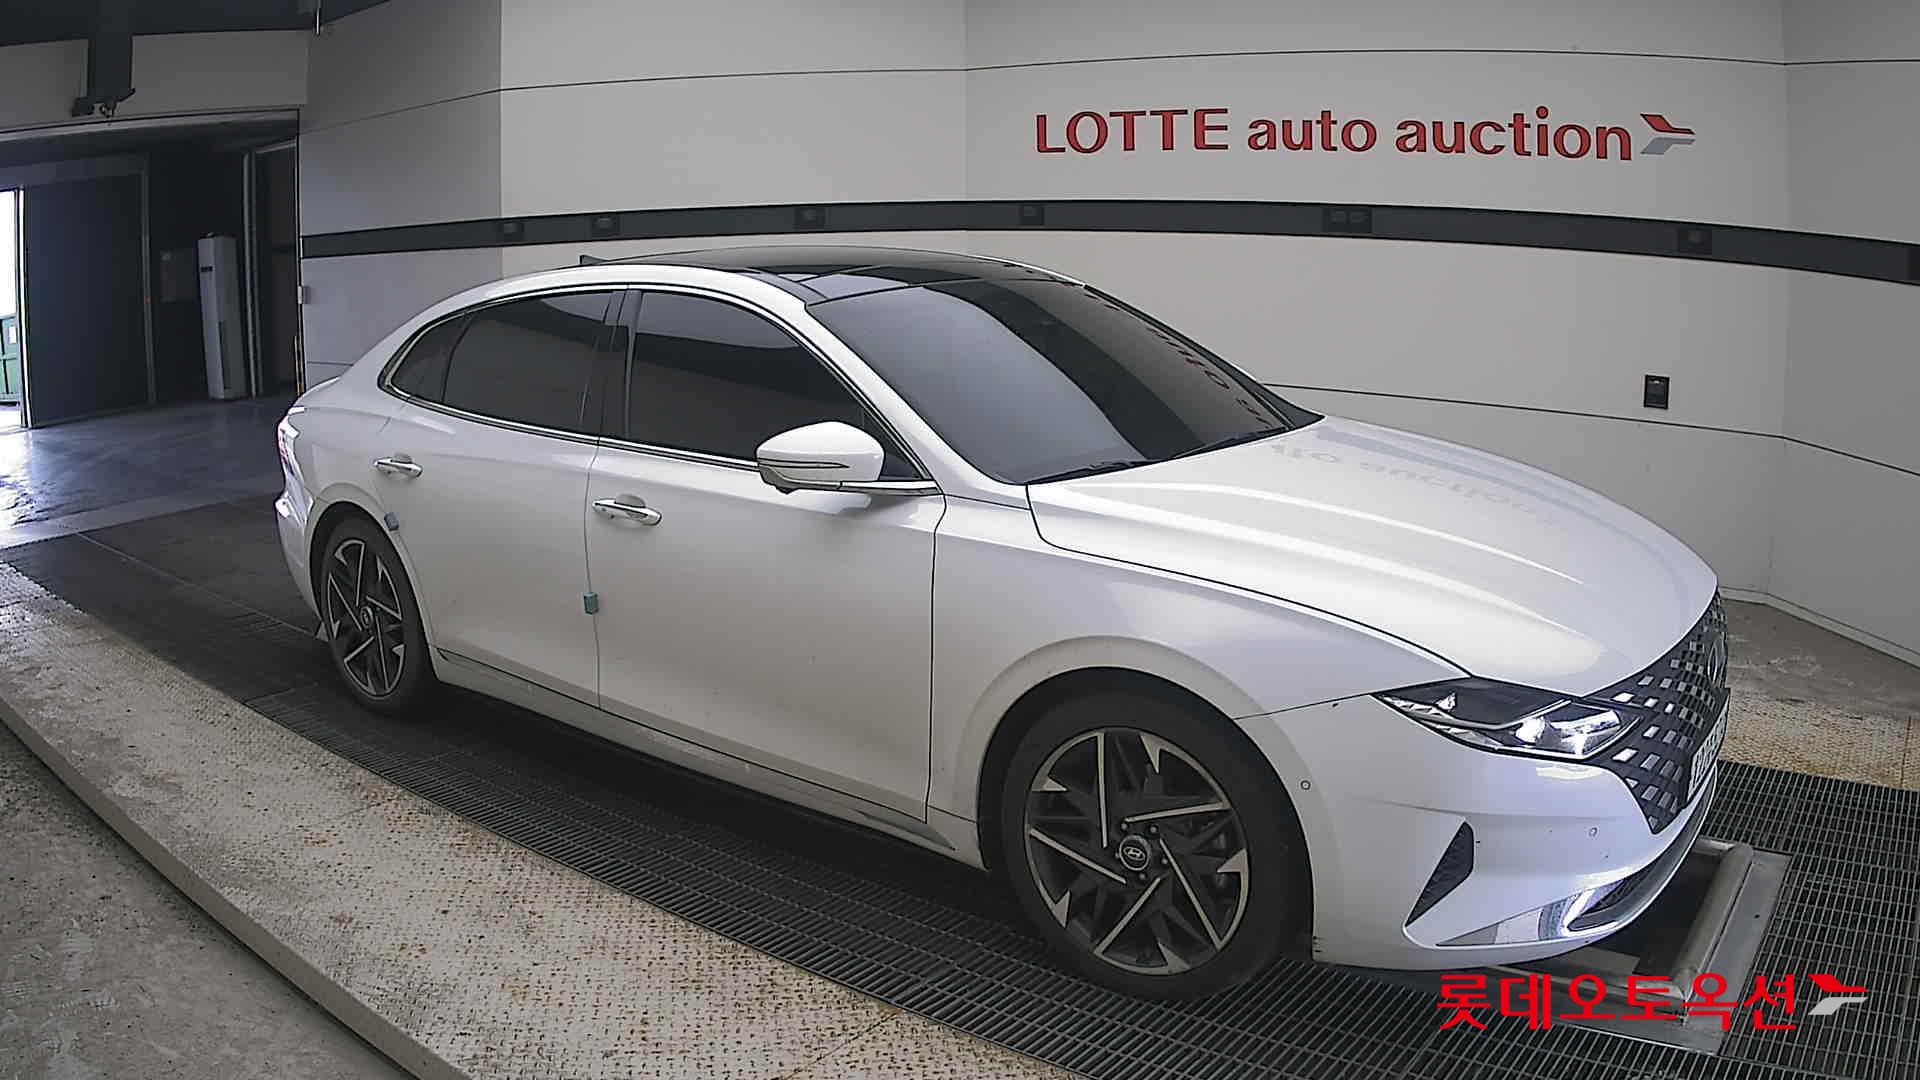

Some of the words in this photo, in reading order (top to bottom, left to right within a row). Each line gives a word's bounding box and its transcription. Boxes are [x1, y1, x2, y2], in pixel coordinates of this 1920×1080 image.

[1036, 107, 1229, 153] LOTTE
[1247, 109, 1377, 152] auto
[1395, 105, 1633, 161] auction
